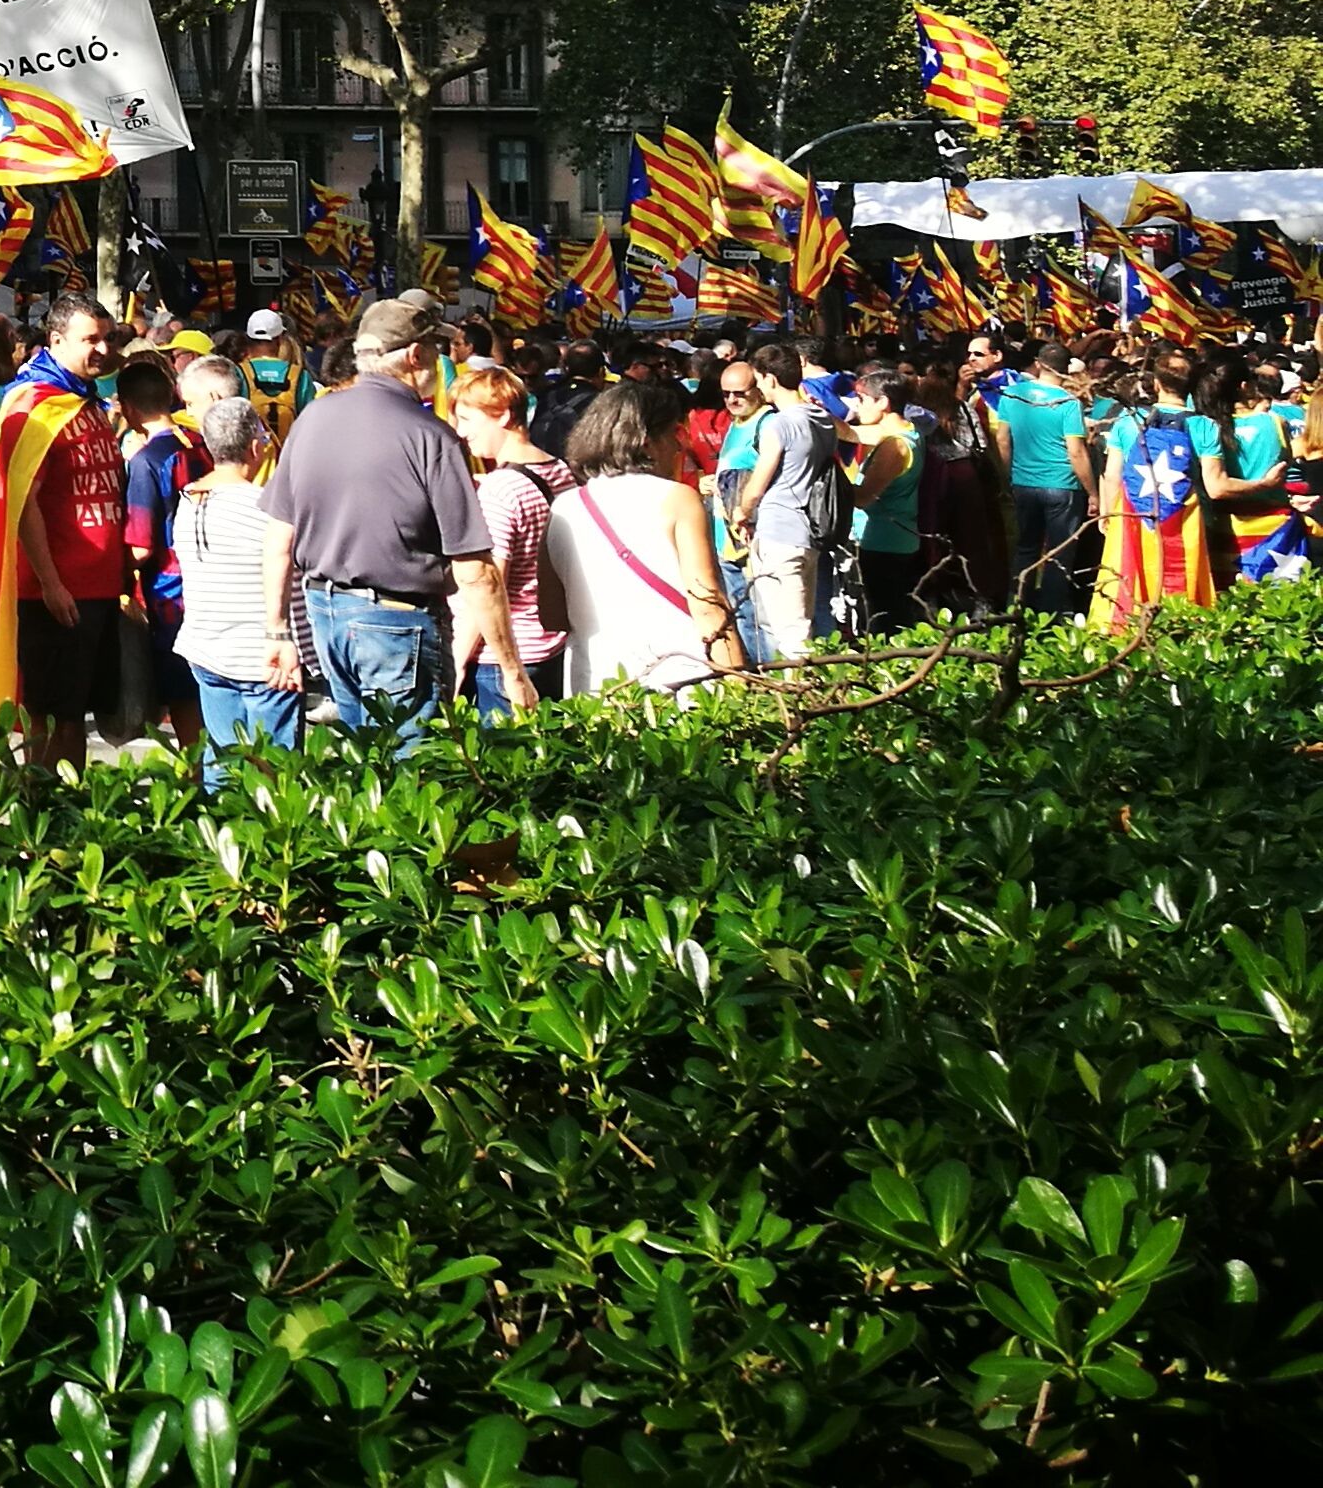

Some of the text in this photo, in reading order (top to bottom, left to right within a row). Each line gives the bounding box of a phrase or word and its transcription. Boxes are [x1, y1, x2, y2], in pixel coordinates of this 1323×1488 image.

[124, 117, 151, 131] CDR
[1232, 276, 1286, 289] Revenge
[1244, 287, 1279, 298] is not
[1242, 297, 1286, 308] Justice
